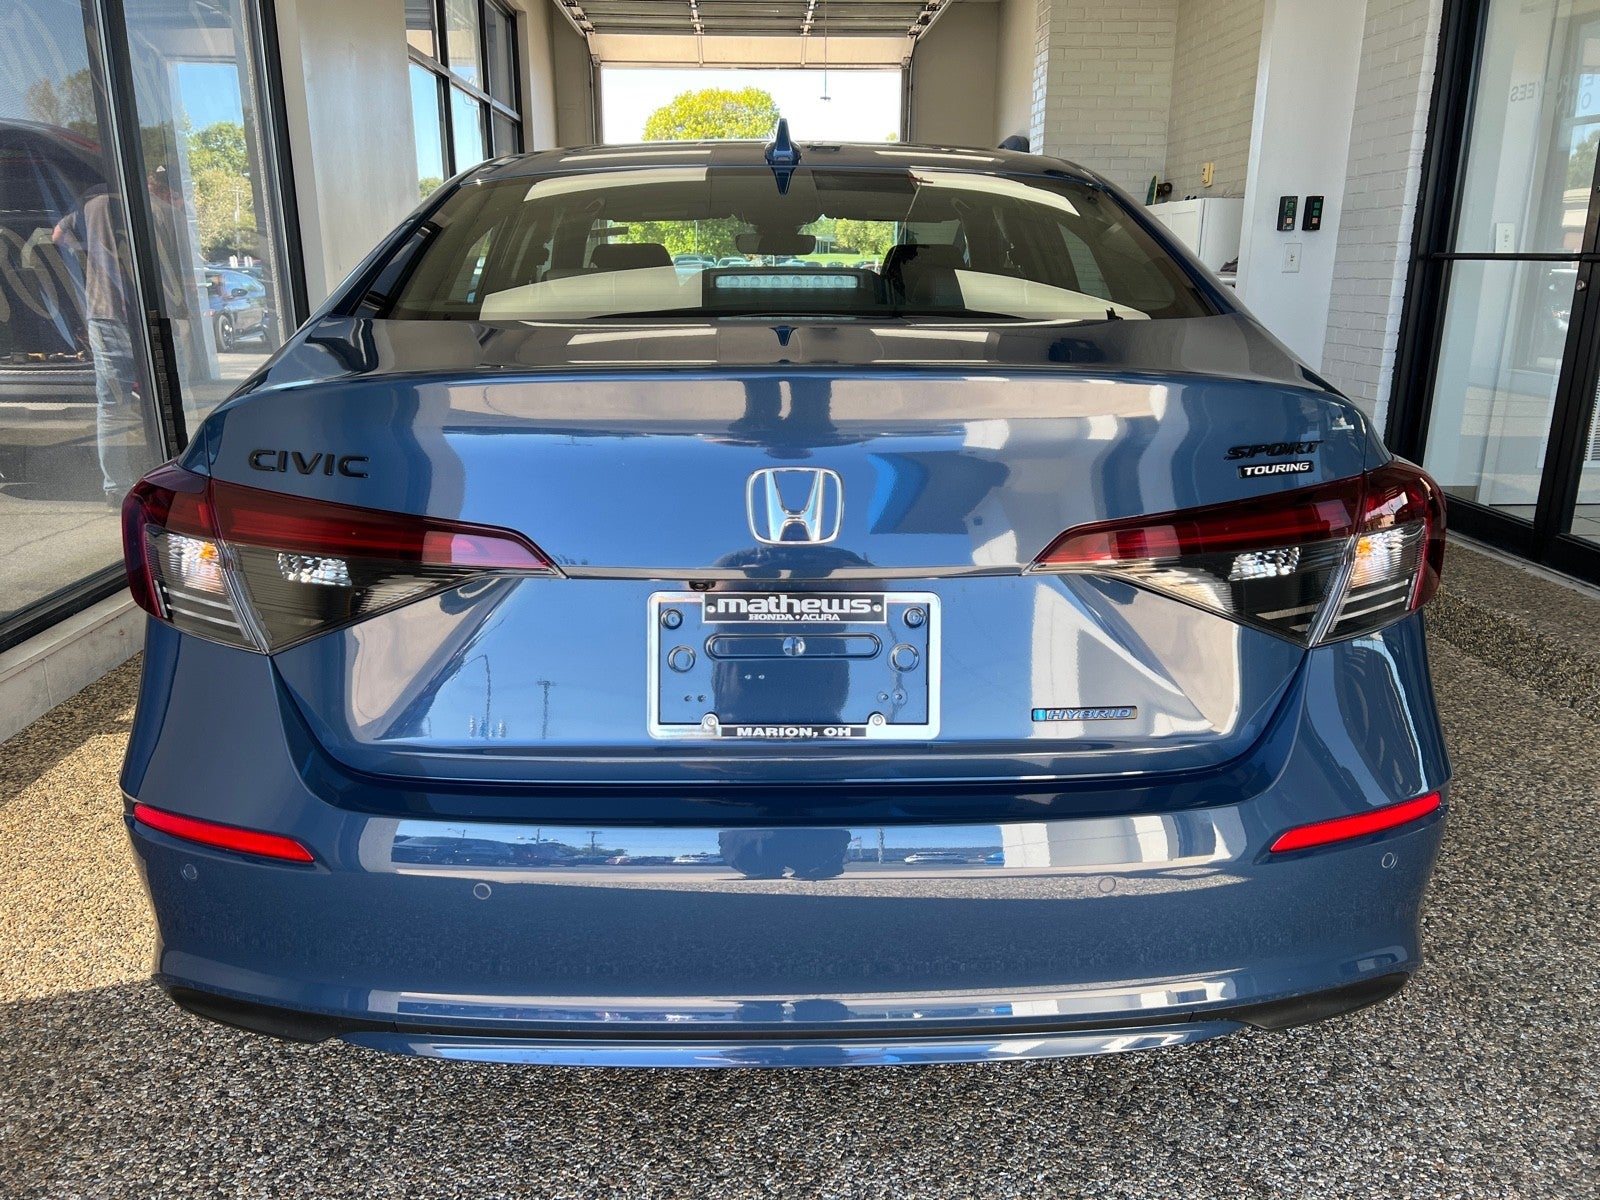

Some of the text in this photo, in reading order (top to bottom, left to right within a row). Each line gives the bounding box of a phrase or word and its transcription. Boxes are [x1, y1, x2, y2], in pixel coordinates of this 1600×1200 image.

[1224, 440, 1323, 460] SPORT
[248, 449, 369, 478] CIVIC
[1244, 462, 1309, 476] TOURING
[717, 595, 871, 613] mathews
[1048, 708, 1132, 719] HYBRID
[736, 727, 851, 737] MARION, OH
